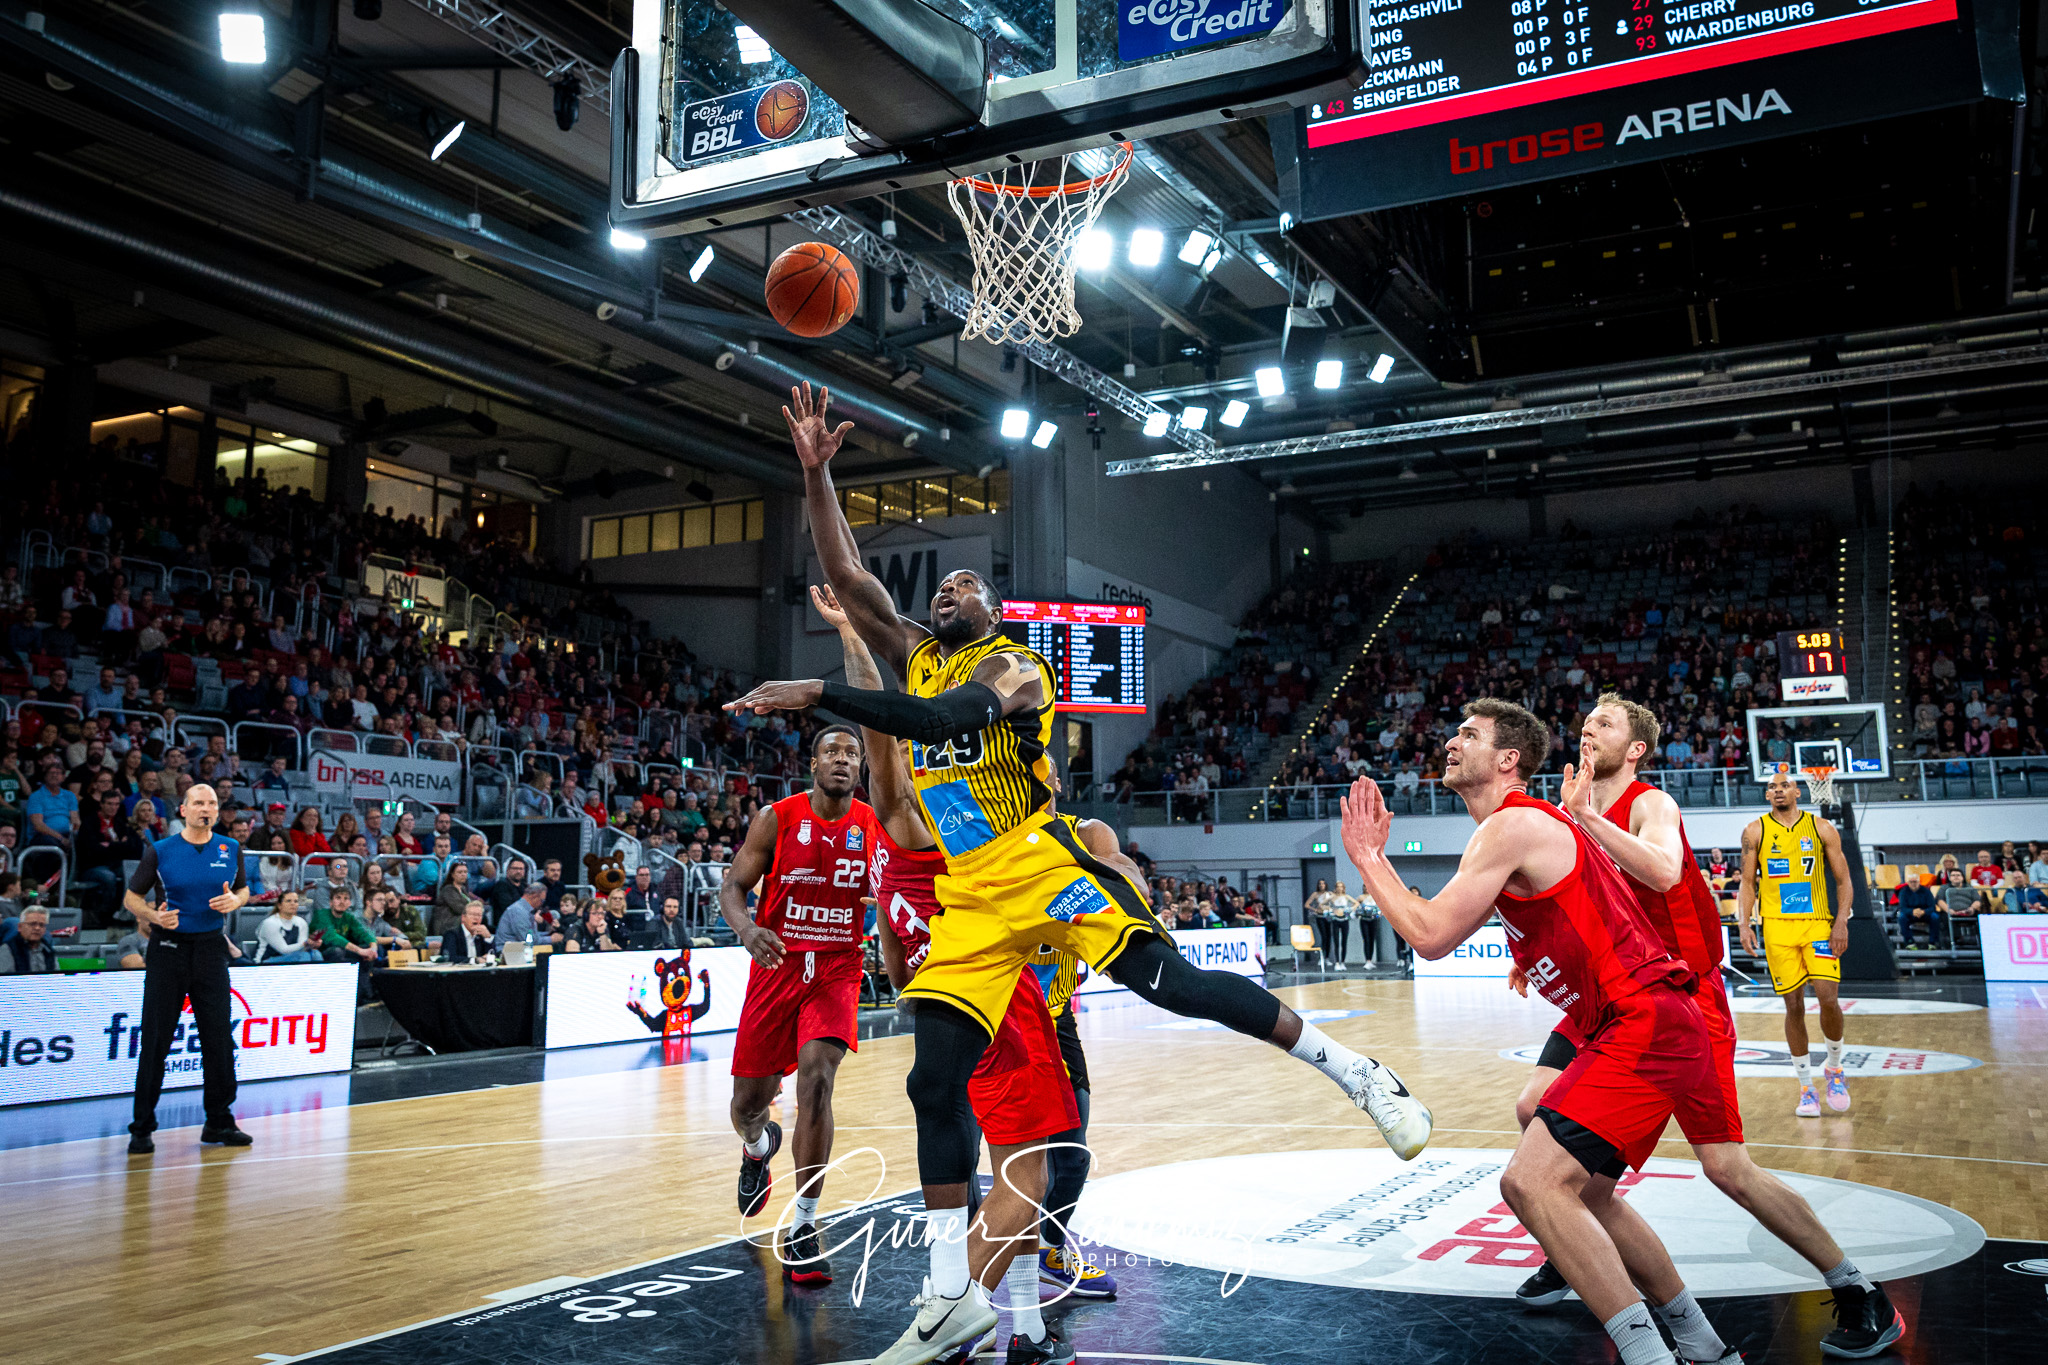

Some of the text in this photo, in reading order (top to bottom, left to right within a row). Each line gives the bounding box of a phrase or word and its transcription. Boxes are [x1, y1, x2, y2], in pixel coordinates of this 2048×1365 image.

[1170, 0, 1272, 42] Credit
[1370, 0, 1462, 28] ACHASHVILI
[1370, 28, 1403, 48] UNG
[1511, 0, 1532, 16] 08
[1633, 0, 1737, 31] 29 CHERRY
[1636, 2, 1815, 51] 93 WAARDENBURG
[1371, 7, 1589, 68] AVES 00 P 0 F
[1358, 27, 1591, 90] ECKMANN 00 P 3 F
[1326, 47, 1593, 114] 43 SENGFELDER 04 P 0 F
[706, 109, 744, 127] Credit
[1449, 88, 1792, 174] brose ARENA
[690, 123, 743, 156] BBL
[1125, 607, 1138, 618] 61
[1808, 652, 1833, 673] 17
[390, 771, 452, 791] ARENA
[833, 858, 866, 889] 22
[1801, 856, 1816, 876] 7
[785, 896, 853, 924] brose
[1049, 881, 1092, 918] Sparda
[1064, 888, 1097, 916] Bank
[784, 921, 829, 934] Internationaler
[1179, 942, 1248, 966] EIN PFAND
[1454, 943, 1513, 958] ENDE
[1524, 956, 1561, 991] se
[1337, 1213, 1413, 1248] Partner
[452, 1287, 592, 1327] Magnequench
